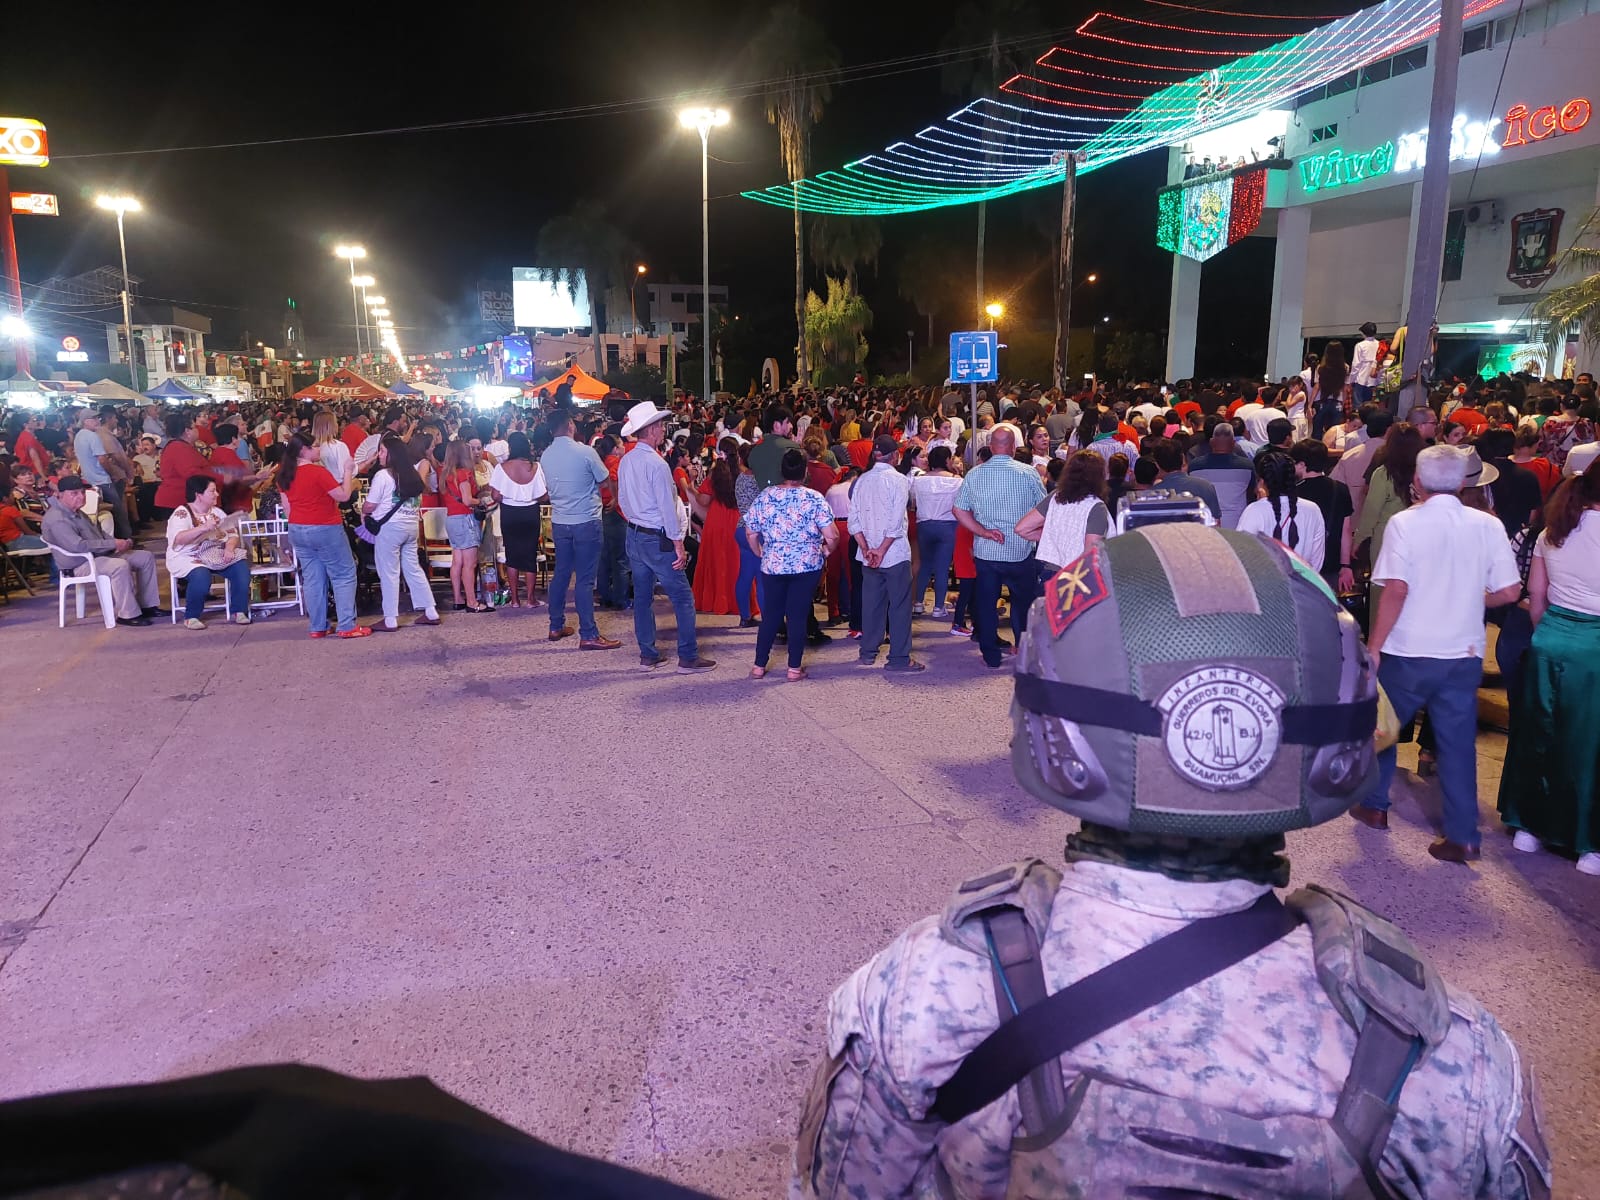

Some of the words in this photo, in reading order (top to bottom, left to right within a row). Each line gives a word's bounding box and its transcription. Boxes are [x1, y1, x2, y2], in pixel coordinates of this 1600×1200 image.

[1299, 140, 1395, 192] Viva
[33, 195, 54, 208] 24
[315, 384, 363, 396] TECATE
[1168, 669, 1274, 704] INFANTERIA
[1173, 686, 1219, 730] GUERREROS
[1223, 685, 1241, 698] DEL
